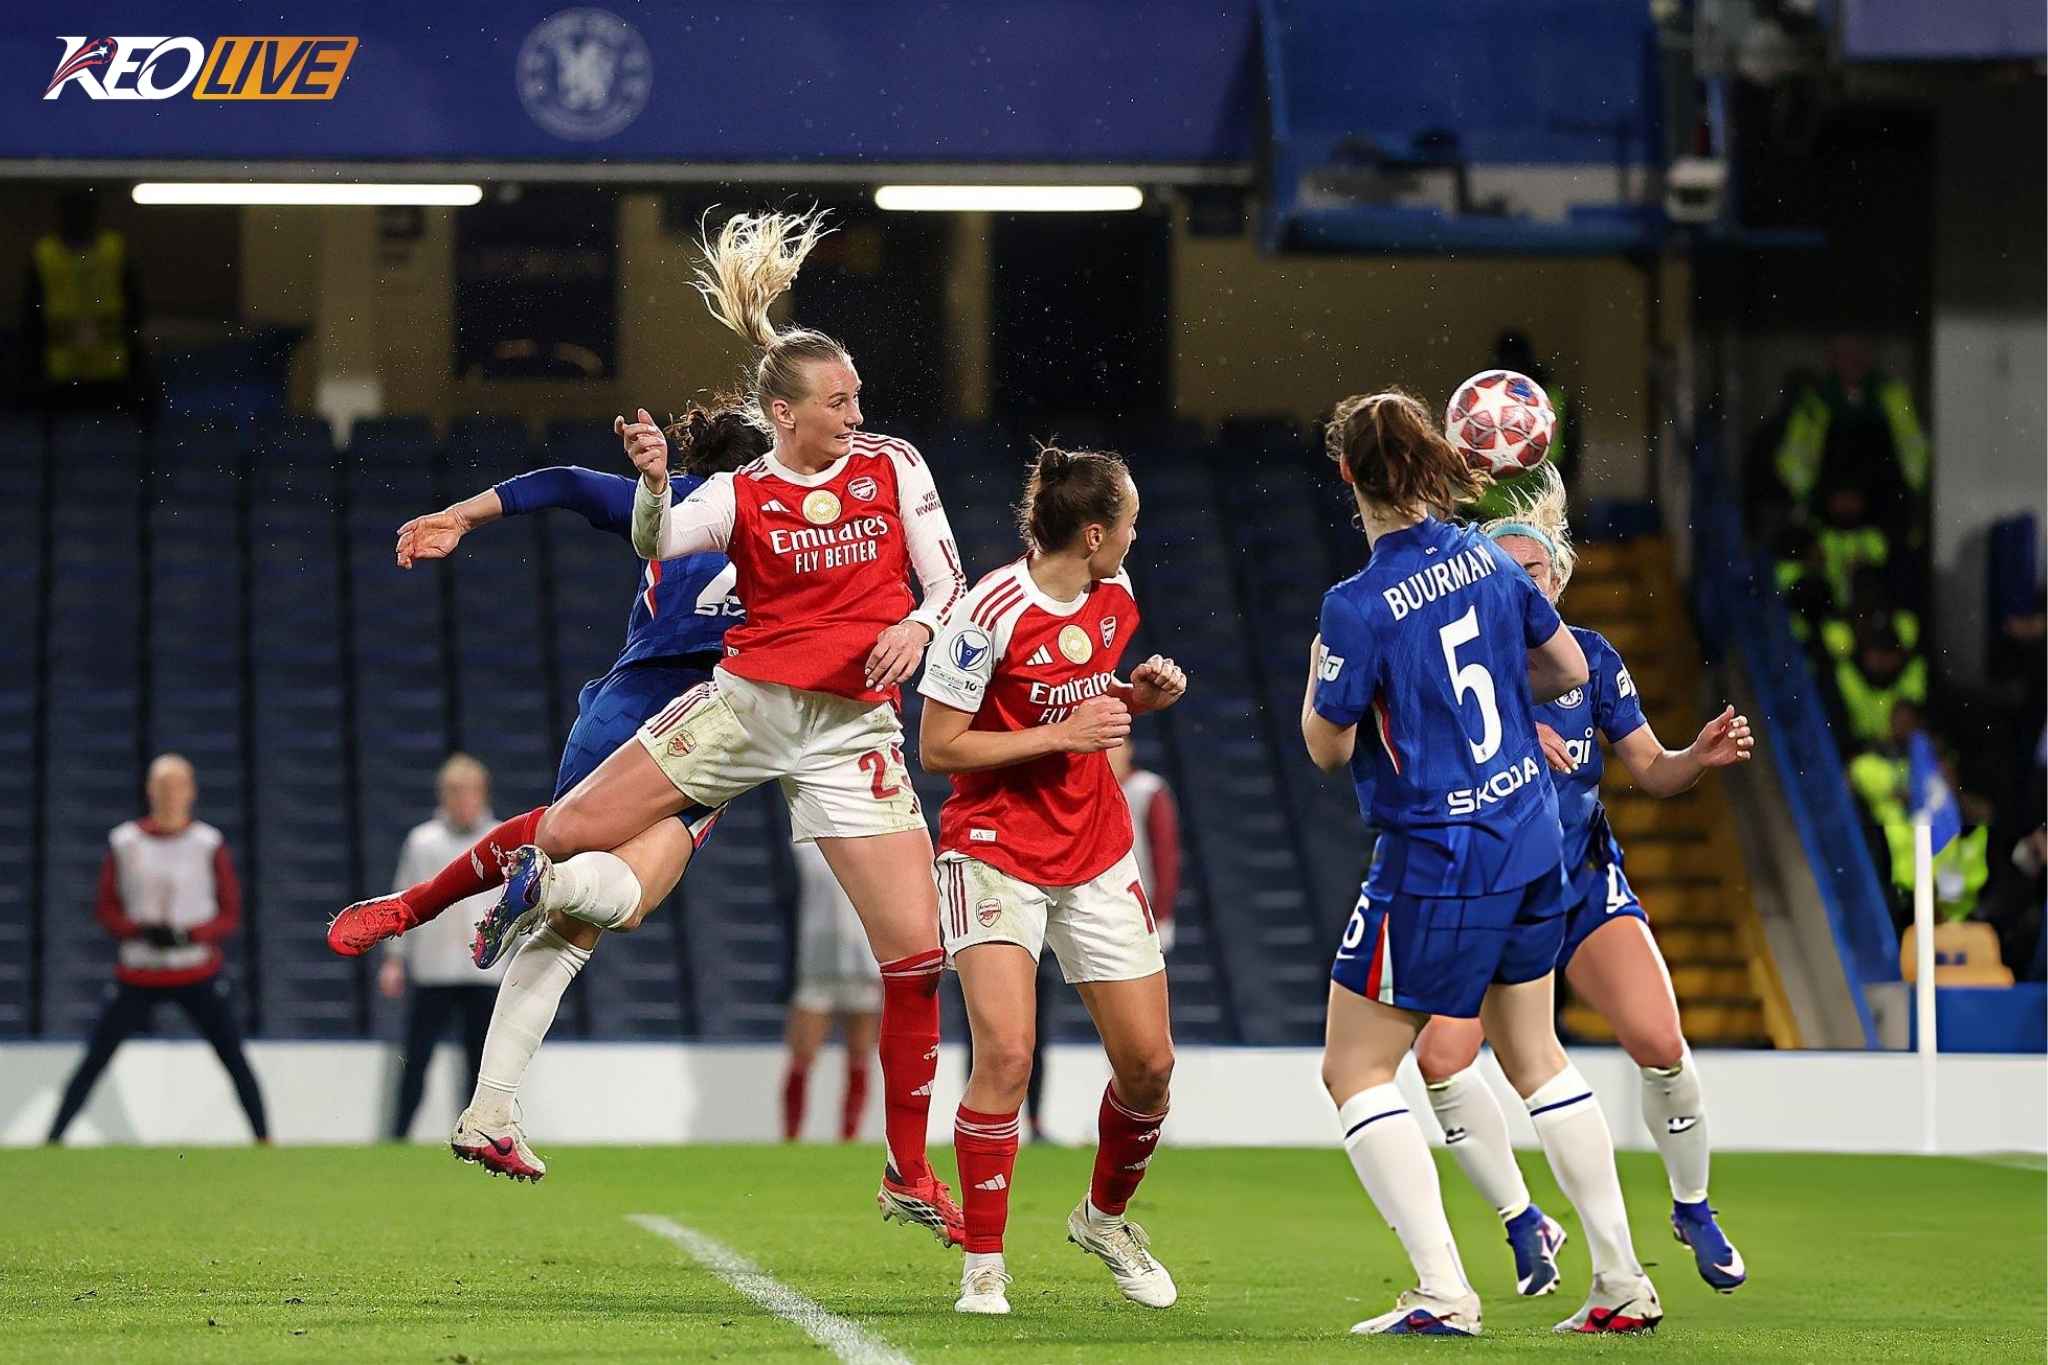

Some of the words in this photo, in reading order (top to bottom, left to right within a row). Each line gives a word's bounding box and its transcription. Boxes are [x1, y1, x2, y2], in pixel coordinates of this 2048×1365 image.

[795, 550, 819, 575] FLY
[825, 539, 878, 569] BETTER
[1383, 545, 1497, 621] BUURMAN
[1029, 671, 1113, 706] Emirate
[1439, 604, 1502, 765] 5
[1038, 707, 1067, 724] FLY
[1564, 727, 1594, 764] ai
[858, 742, 913, 800] 2
